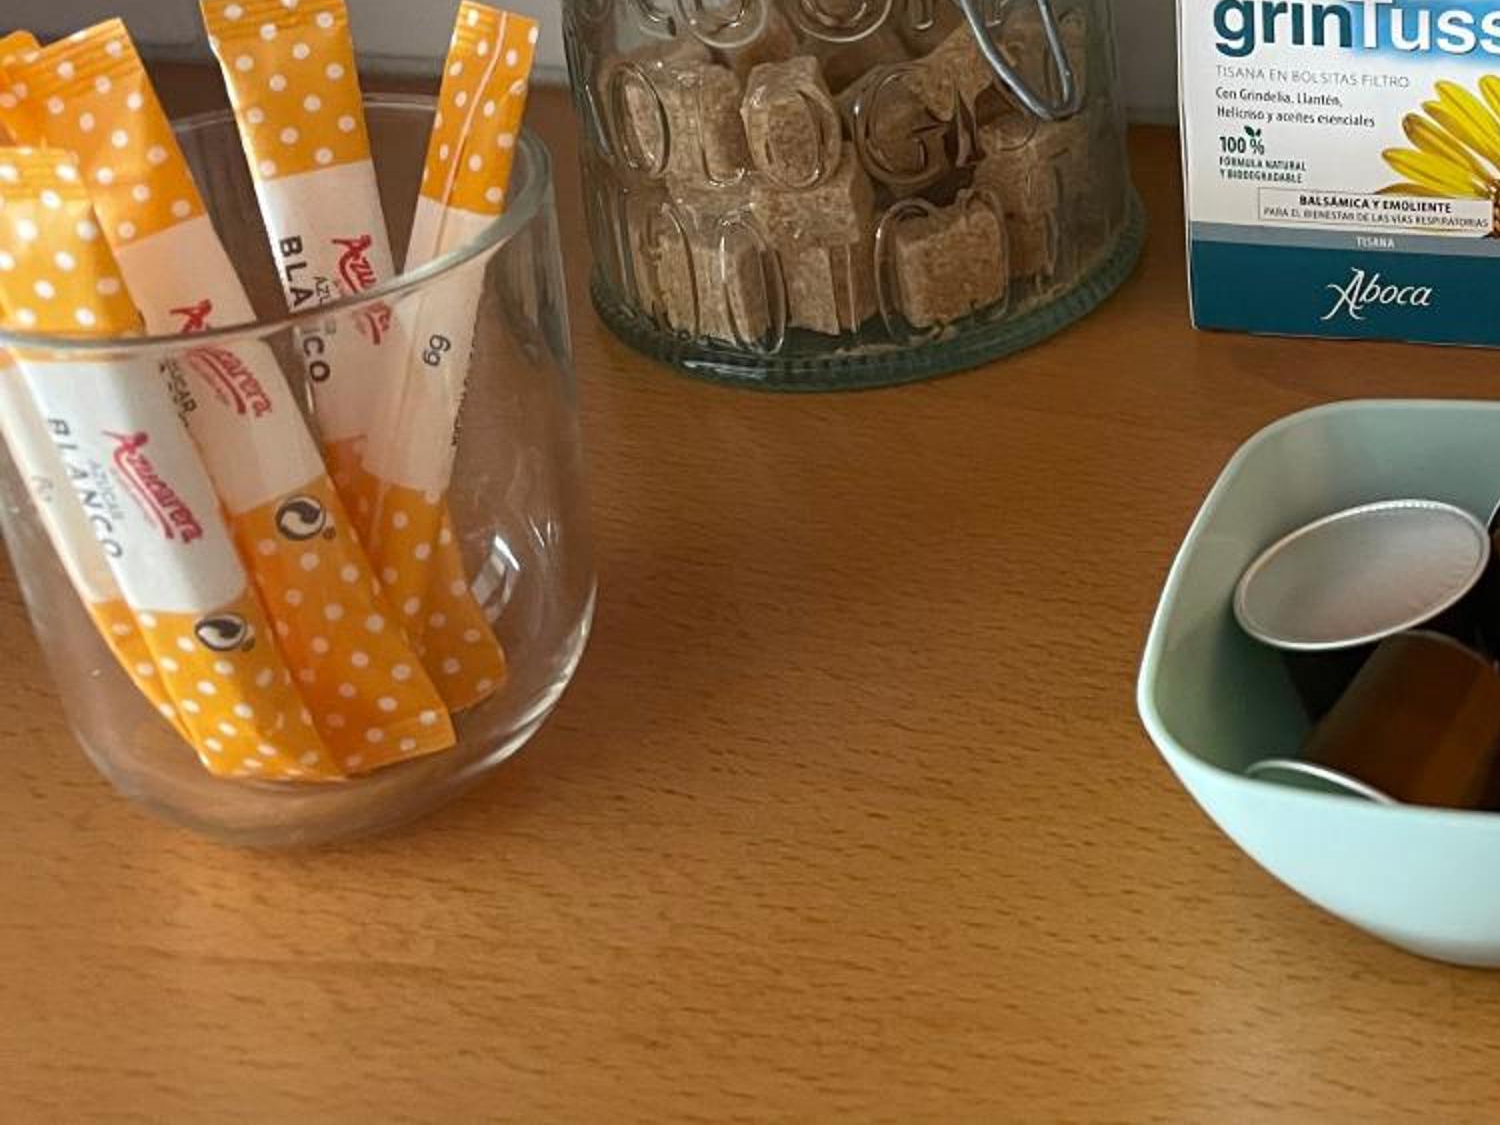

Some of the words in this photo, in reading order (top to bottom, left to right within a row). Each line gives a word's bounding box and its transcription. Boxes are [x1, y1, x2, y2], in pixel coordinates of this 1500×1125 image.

[1216, 65, 1265, 79] TISANA
[1269, 69, 1288, 81] EN
[1293, 71, 1357, 86] BOLSITAS
[1362, 75, 1410, 88] FILTRO
[1216, 87, 1237, 99] Con
[1276, 110, 1315, 124] aceites
[1318, 114, 1375, 127] esenciales
[1265, 160, 1306, 171] NATURAL
[1227, 170, 1303, 184] BIODEGRADABLE
[1299, 194, 1371, 210] BALSÁMICA
[1373, 199, 1380, 210] Y
[1383, 199, 1452, 214] EMOLIENTE
[1263, 207, 1289, 218] PARA
[1304, 209, 1355, 222] BIENESTAR
[1357, 212, 1369, 222] DE
[1371, 213, 1389, 223] LAS
[1415, 215, 1489, 227] RESPIRATORIAS
[1356, 236, 1394, 248] TISANA
[1320, 266, 1433, 320] Aboca
